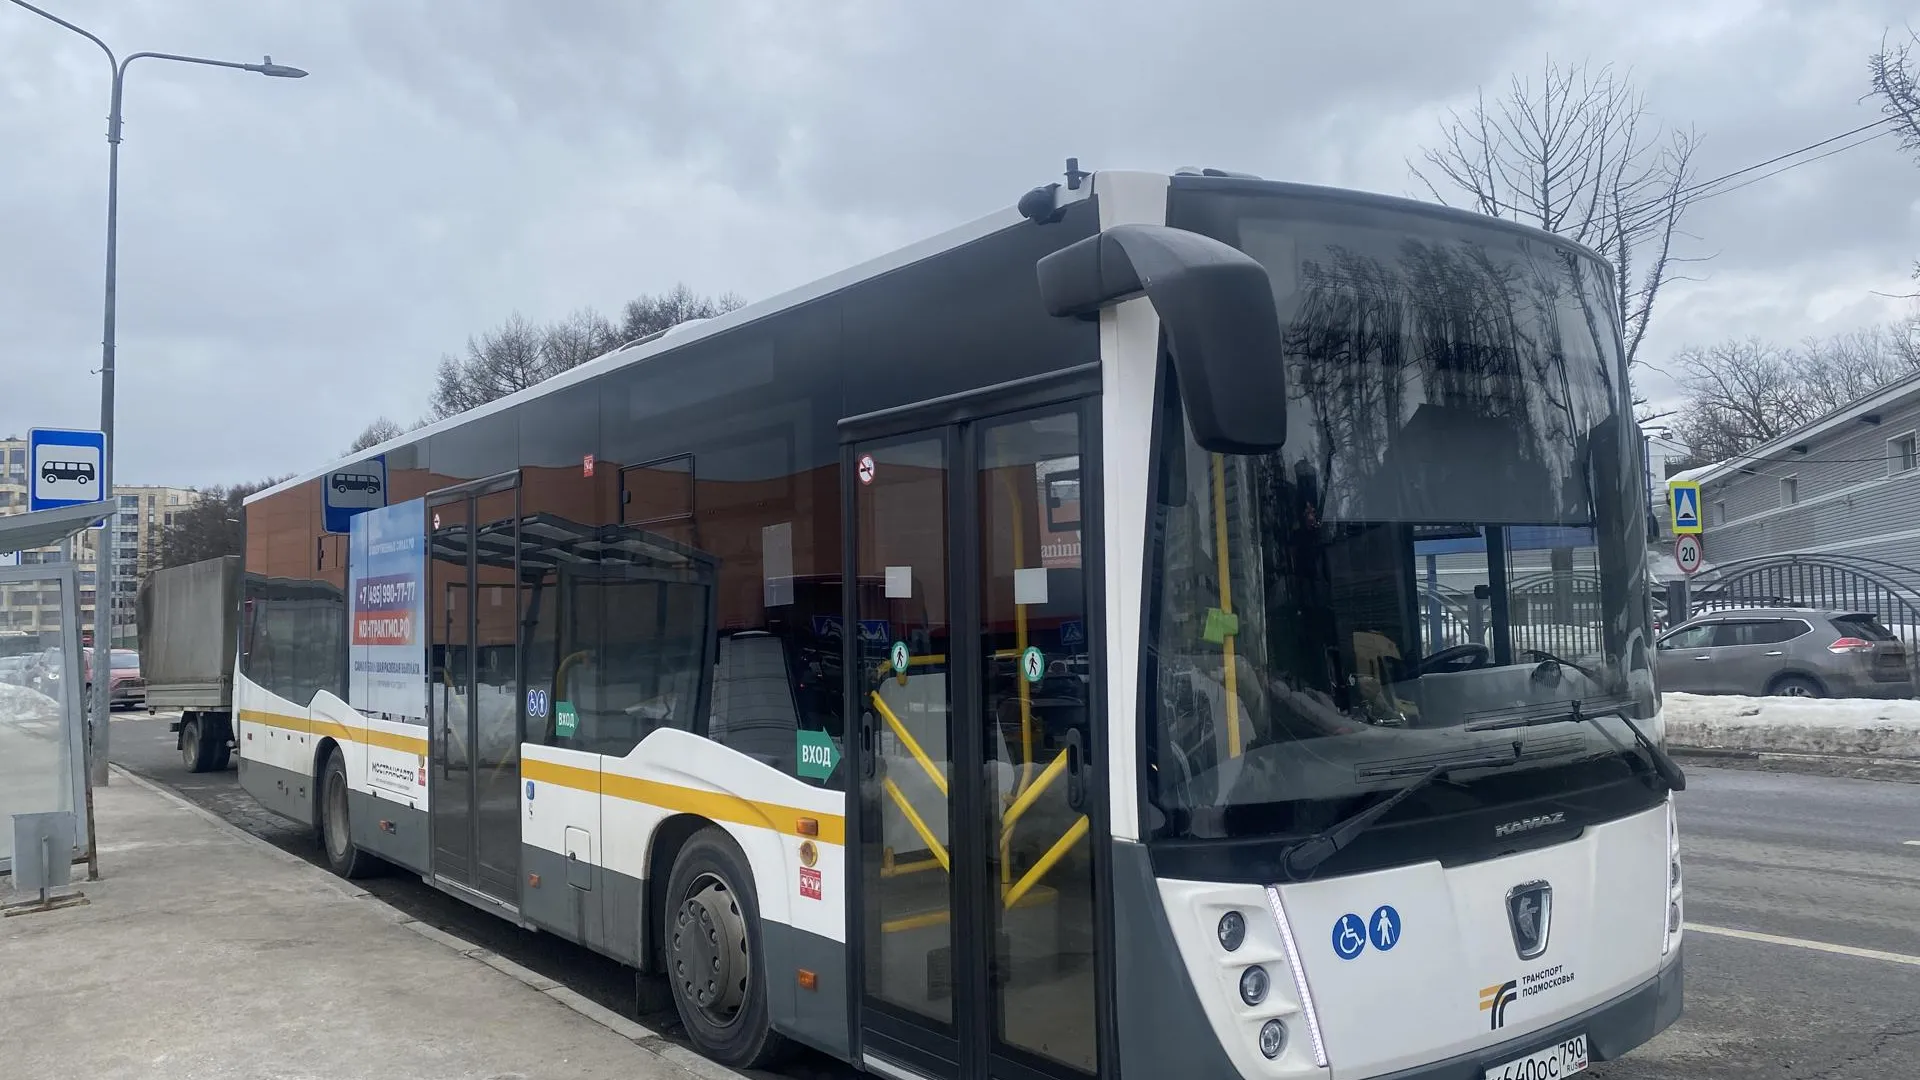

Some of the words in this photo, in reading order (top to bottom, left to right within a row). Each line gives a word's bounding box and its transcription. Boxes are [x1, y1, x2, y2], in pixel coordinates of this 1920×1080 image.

[1682, 546, 1695, 562] 20
[360, 586, 367, 605] +7
[367, 583, 382, 609] (495)
[382, 581, 416, 603] 990-77-77
[358, 616, 411, 639] КОНТРАКТМО.РФ
[558, 712, 575, 728] ВХОД
[802, 745, 831, 767] ВХОД
[1495, 811, 1567, 837] KAMAZ
[1522, 965, 1563, 985] ТРАНСПОРТ
[1522, 972, 1575, 998] ПОДМОСКОВЬЯ
[1560, 1037, 1584, 1066] 790
[1566, 1063, 1579, 1072] RUS
